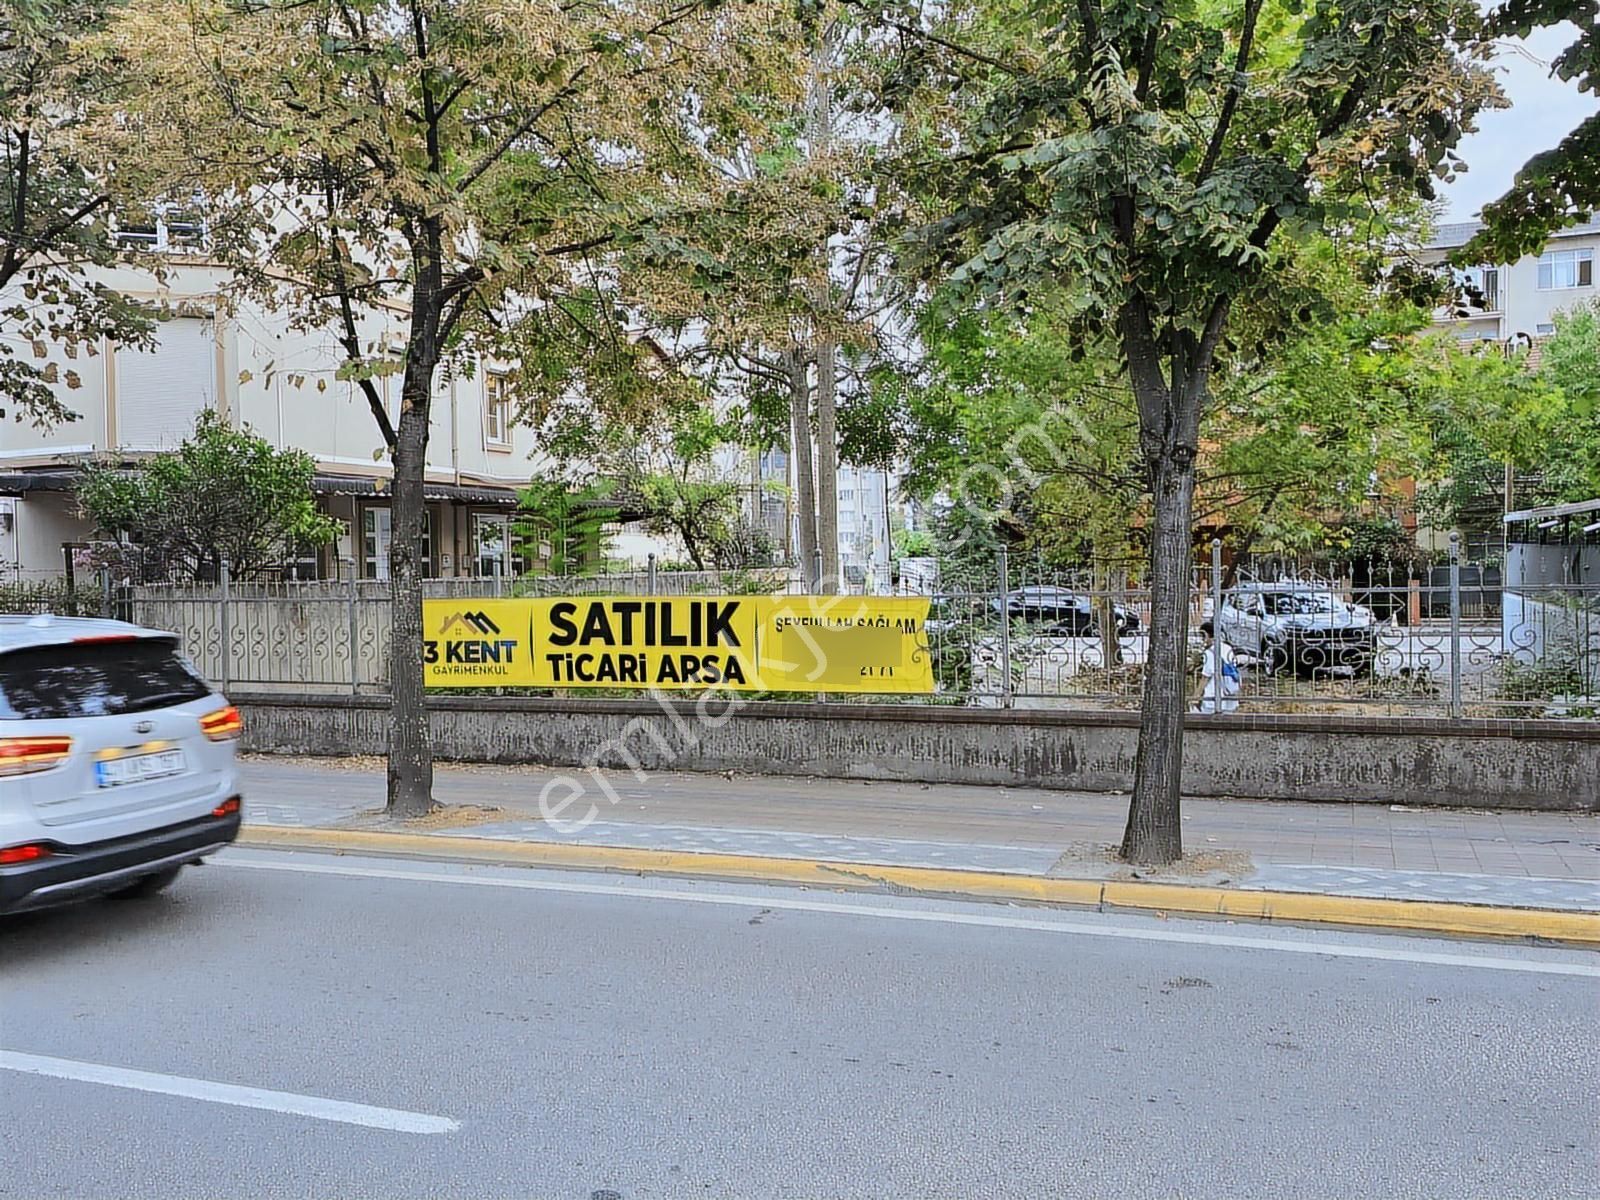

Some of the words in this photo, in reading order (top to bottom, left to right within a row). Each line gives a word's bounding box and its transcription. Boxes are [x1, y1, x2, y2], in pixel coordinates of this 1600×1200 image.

[548, 601, 741, 647] SATILIK
[446, 640, 517, 663] KENT
[656, 654, 746, 684] ARSA
